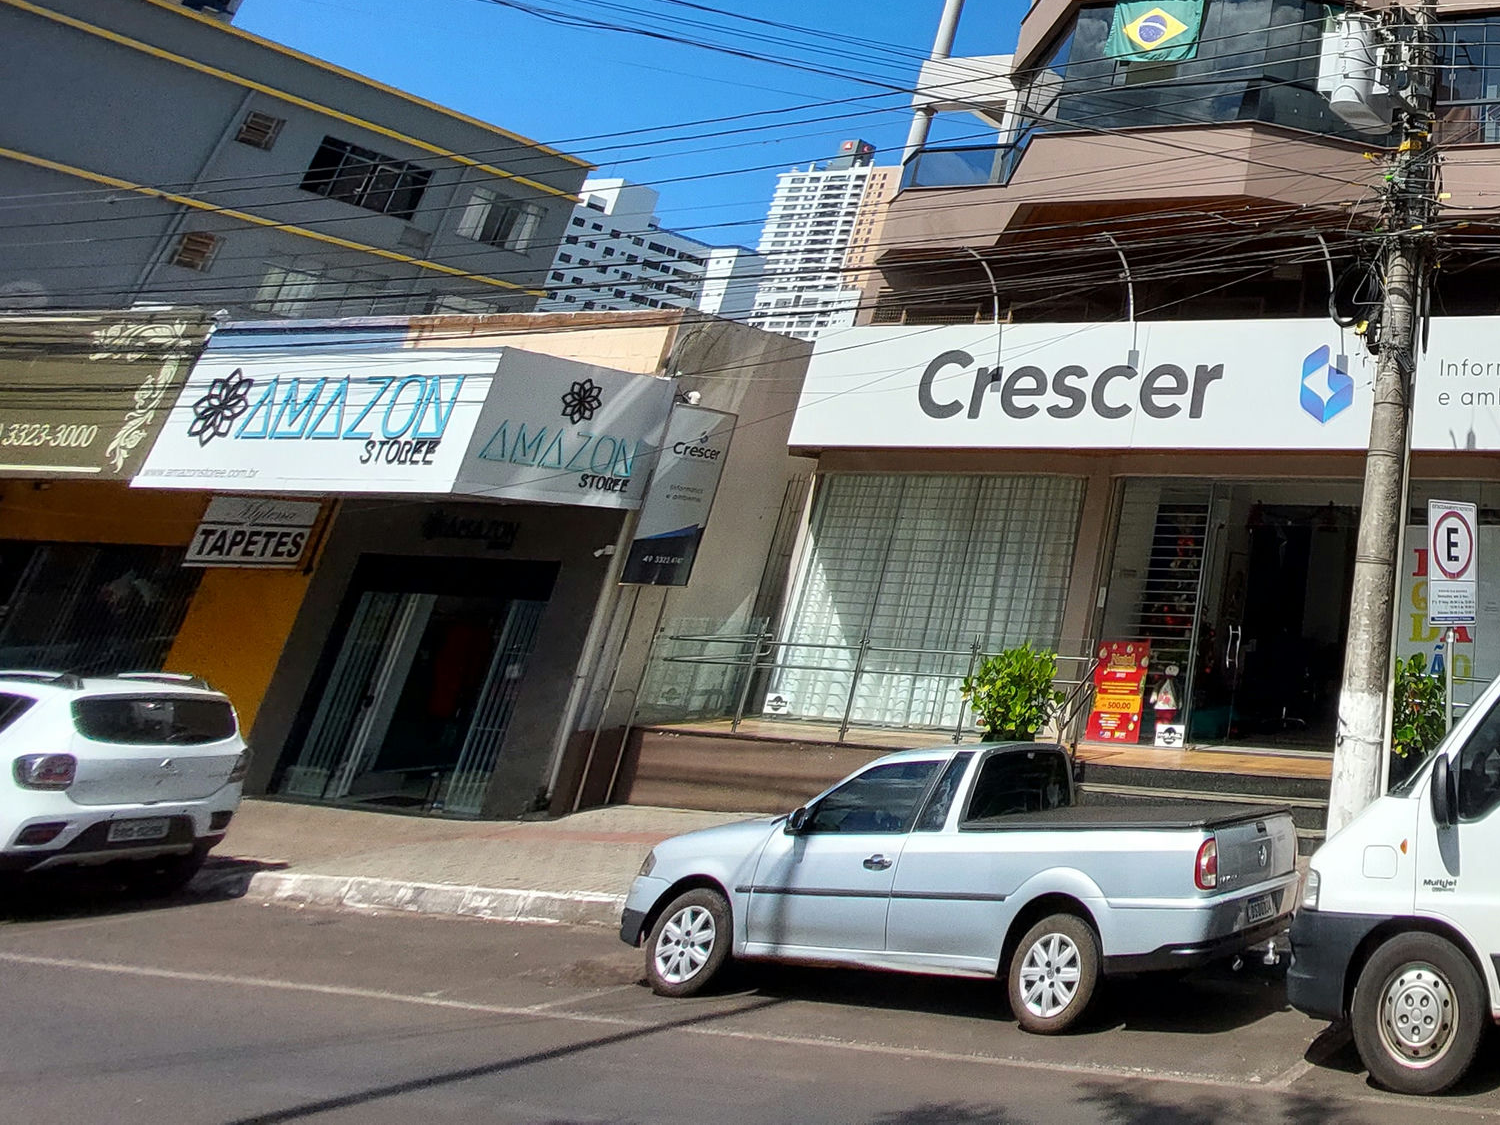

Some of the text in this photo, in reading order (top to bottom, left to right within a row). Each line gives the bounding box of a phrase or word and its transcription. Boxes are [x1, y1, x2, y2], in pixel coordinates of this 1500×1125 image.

[918, 349, 1225, 419] Crescer
[1438, 392, 1450, 406] e
[234, 374, 465, 440] AMAZON
[2, 424, 99, 448] 3323-3000
[478, 419, 641, 478] AMAZON
[673, 441, 721, 461] Crescer
[196, 528, 305, 558] TAPETES
[1446, 526, 1460, 562] E
